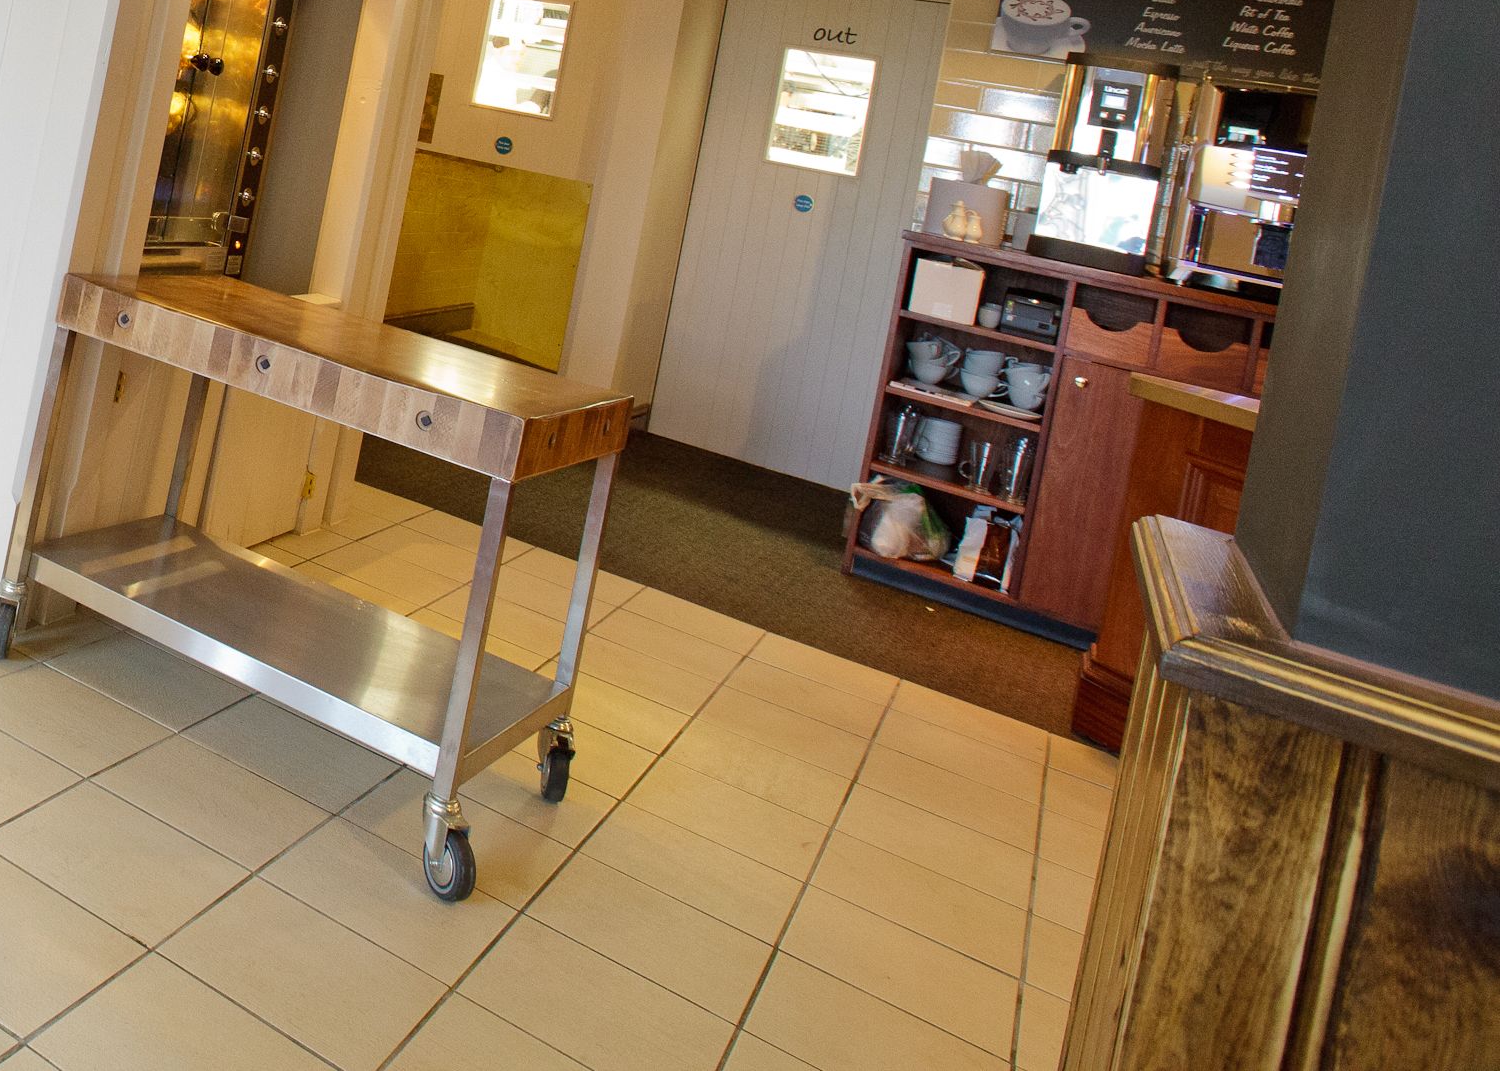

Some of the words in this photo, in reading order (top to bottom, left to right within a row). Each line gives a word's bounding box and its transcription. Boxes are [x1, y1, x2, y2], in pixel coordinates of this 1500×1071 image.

[1142, 7, 1180, 21] Espresso
[1239, 5, 1258, 18] Pot
[1258, 8, 1273, 19] of
[1273, 9, 1291, 21] Tea
[814, 26, 857, 45] out
[1134, 22, 1182, 37] Americano
[1230, 21, 1260, 34] White
[1262, 25, 1295, 39] Coffee
[1124, 36, 1157, 50] Mocha
[1161, 41, 1186, 54] Latte
[1222, 37, 1260, 51] Liqueur
[1263, 41, 1297, 56] Coffee
